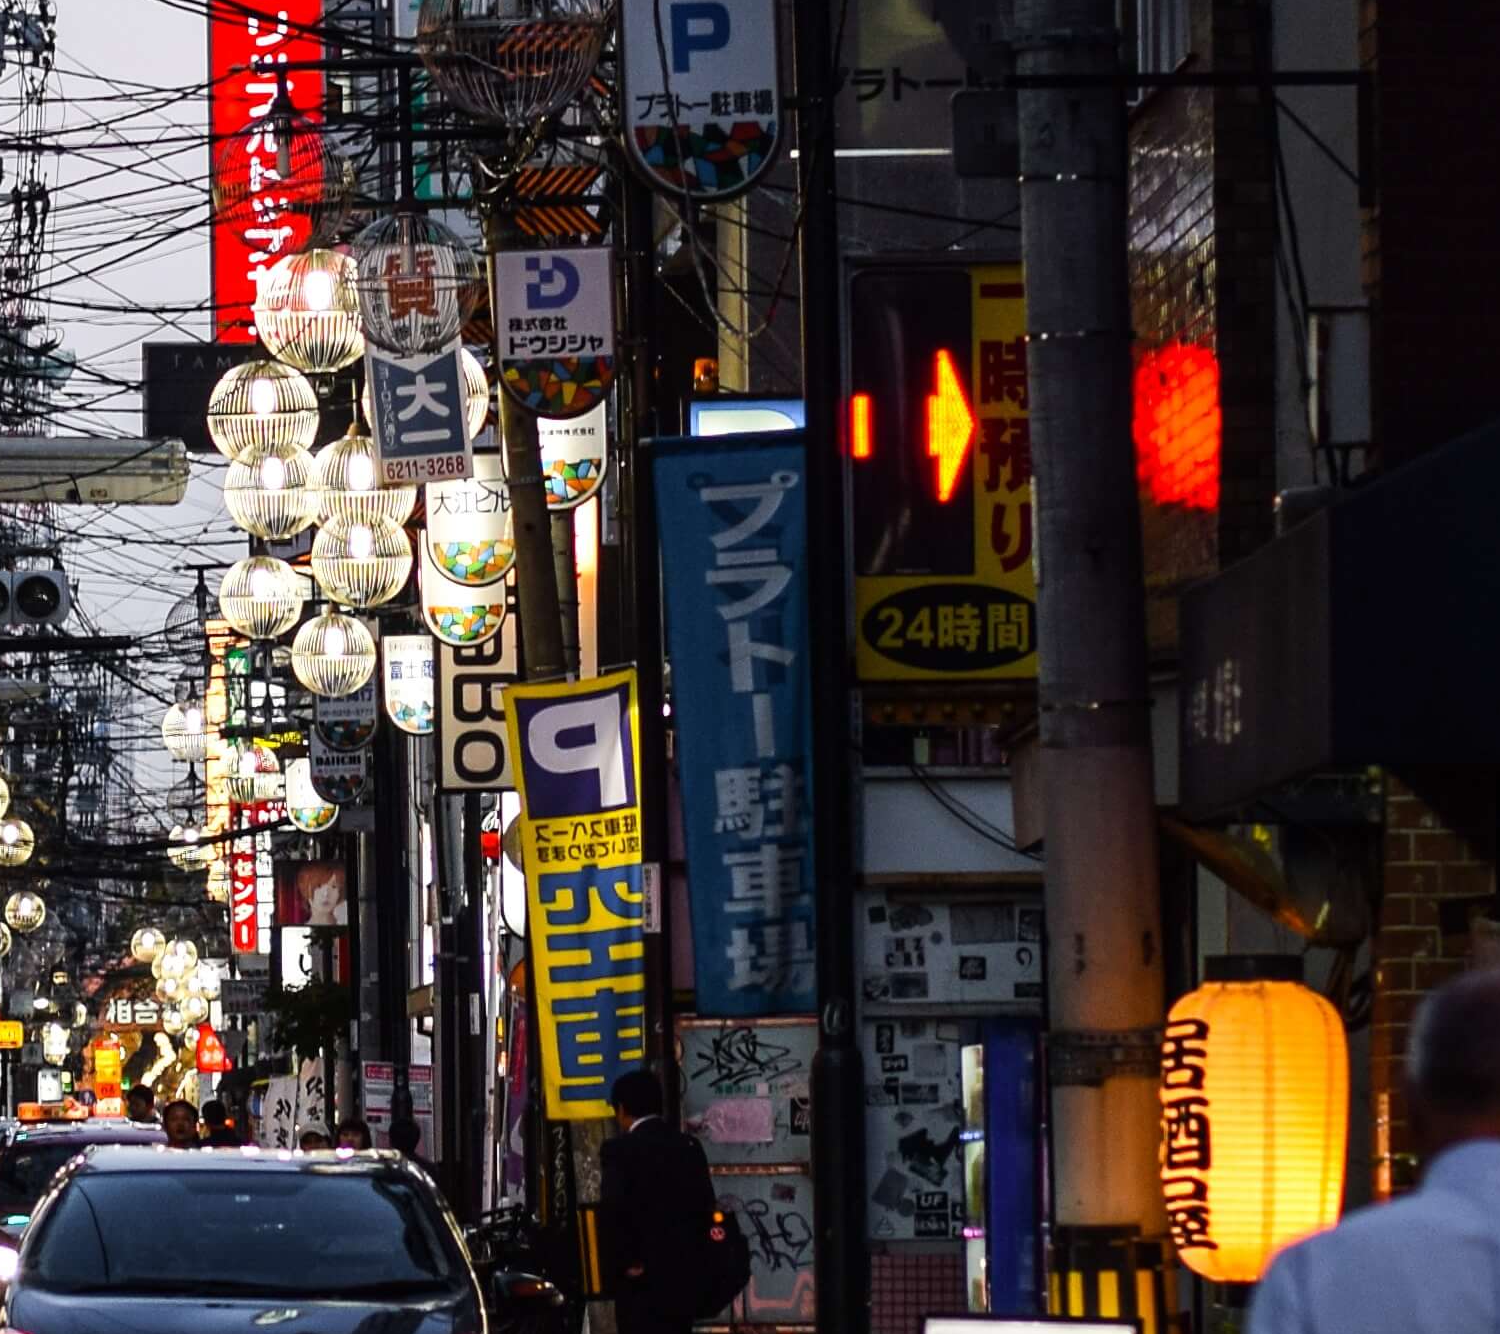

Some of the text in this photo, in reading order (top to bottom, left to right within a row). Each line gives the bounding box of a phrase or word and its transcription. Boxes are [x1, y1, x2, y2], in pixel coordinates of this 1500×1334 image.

[670, 2, 731, 74] P
[635, 90, 774, 120] プラトー駐車場
[509, 318, 568, 332] 株式会社
[509, 334, 604, 355] ドウシシャ
[386, 455, 466, 481] 6211-3268
[432, 488, 513, 516] 大江ビル
[875, 602, 1032, 654] 24時間
[698, 471, 816, 996] プラトー駐車場
